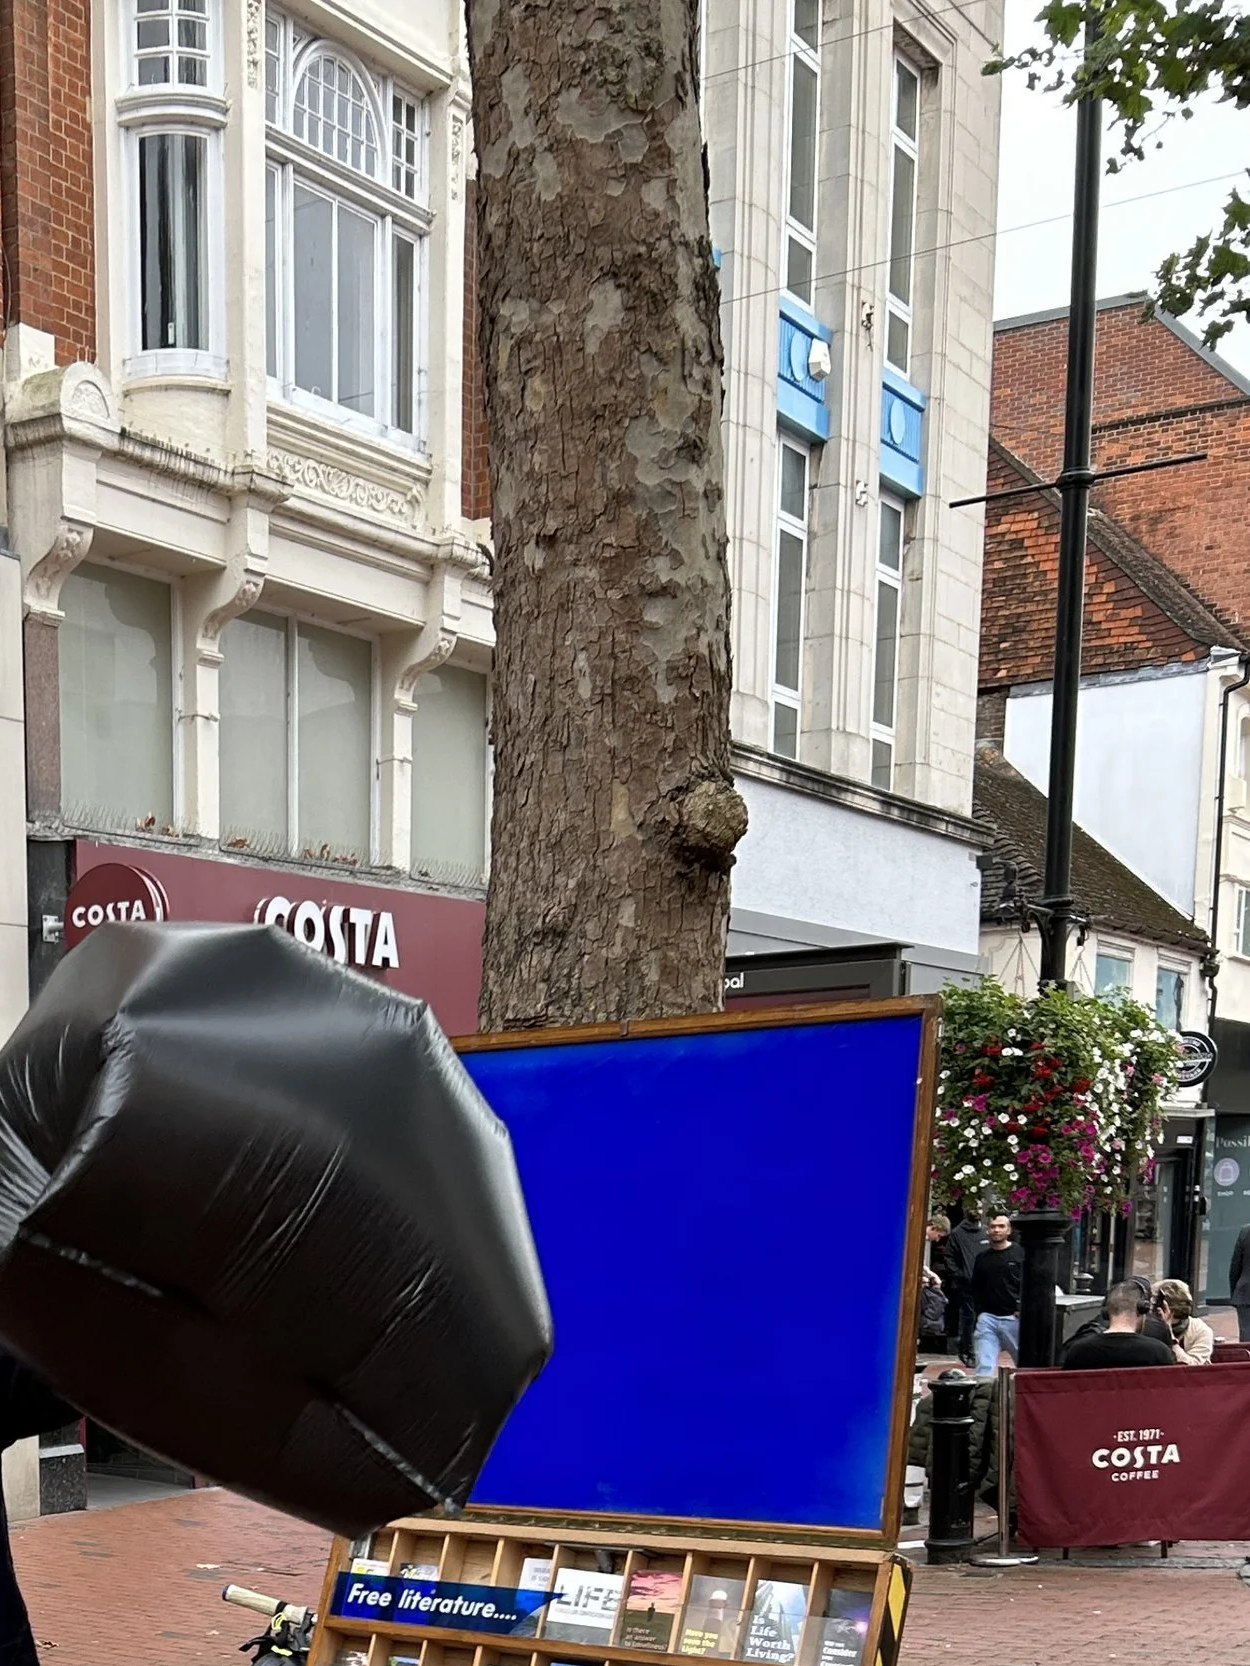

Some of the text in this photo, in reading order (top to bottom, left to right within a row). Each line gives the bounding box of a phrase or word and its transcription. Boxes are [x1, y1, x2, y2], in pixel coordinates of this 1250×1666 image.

[71, 900, 147, 929] COSTA
[1092, 1443, 1181, 1469] COSTA
[1111, 1470, 1159, 1482] COFFEE
[347, 1583, 517, 1621] Free literature....
[554, 1584, 621, 1611] LIFE
[753, 1615, 765, 1625] Is
[750, 1626, 777, 1638] Life
[749, 1637, 792, 1651] Worth
[746, 1648, 794, 1664] Living?
